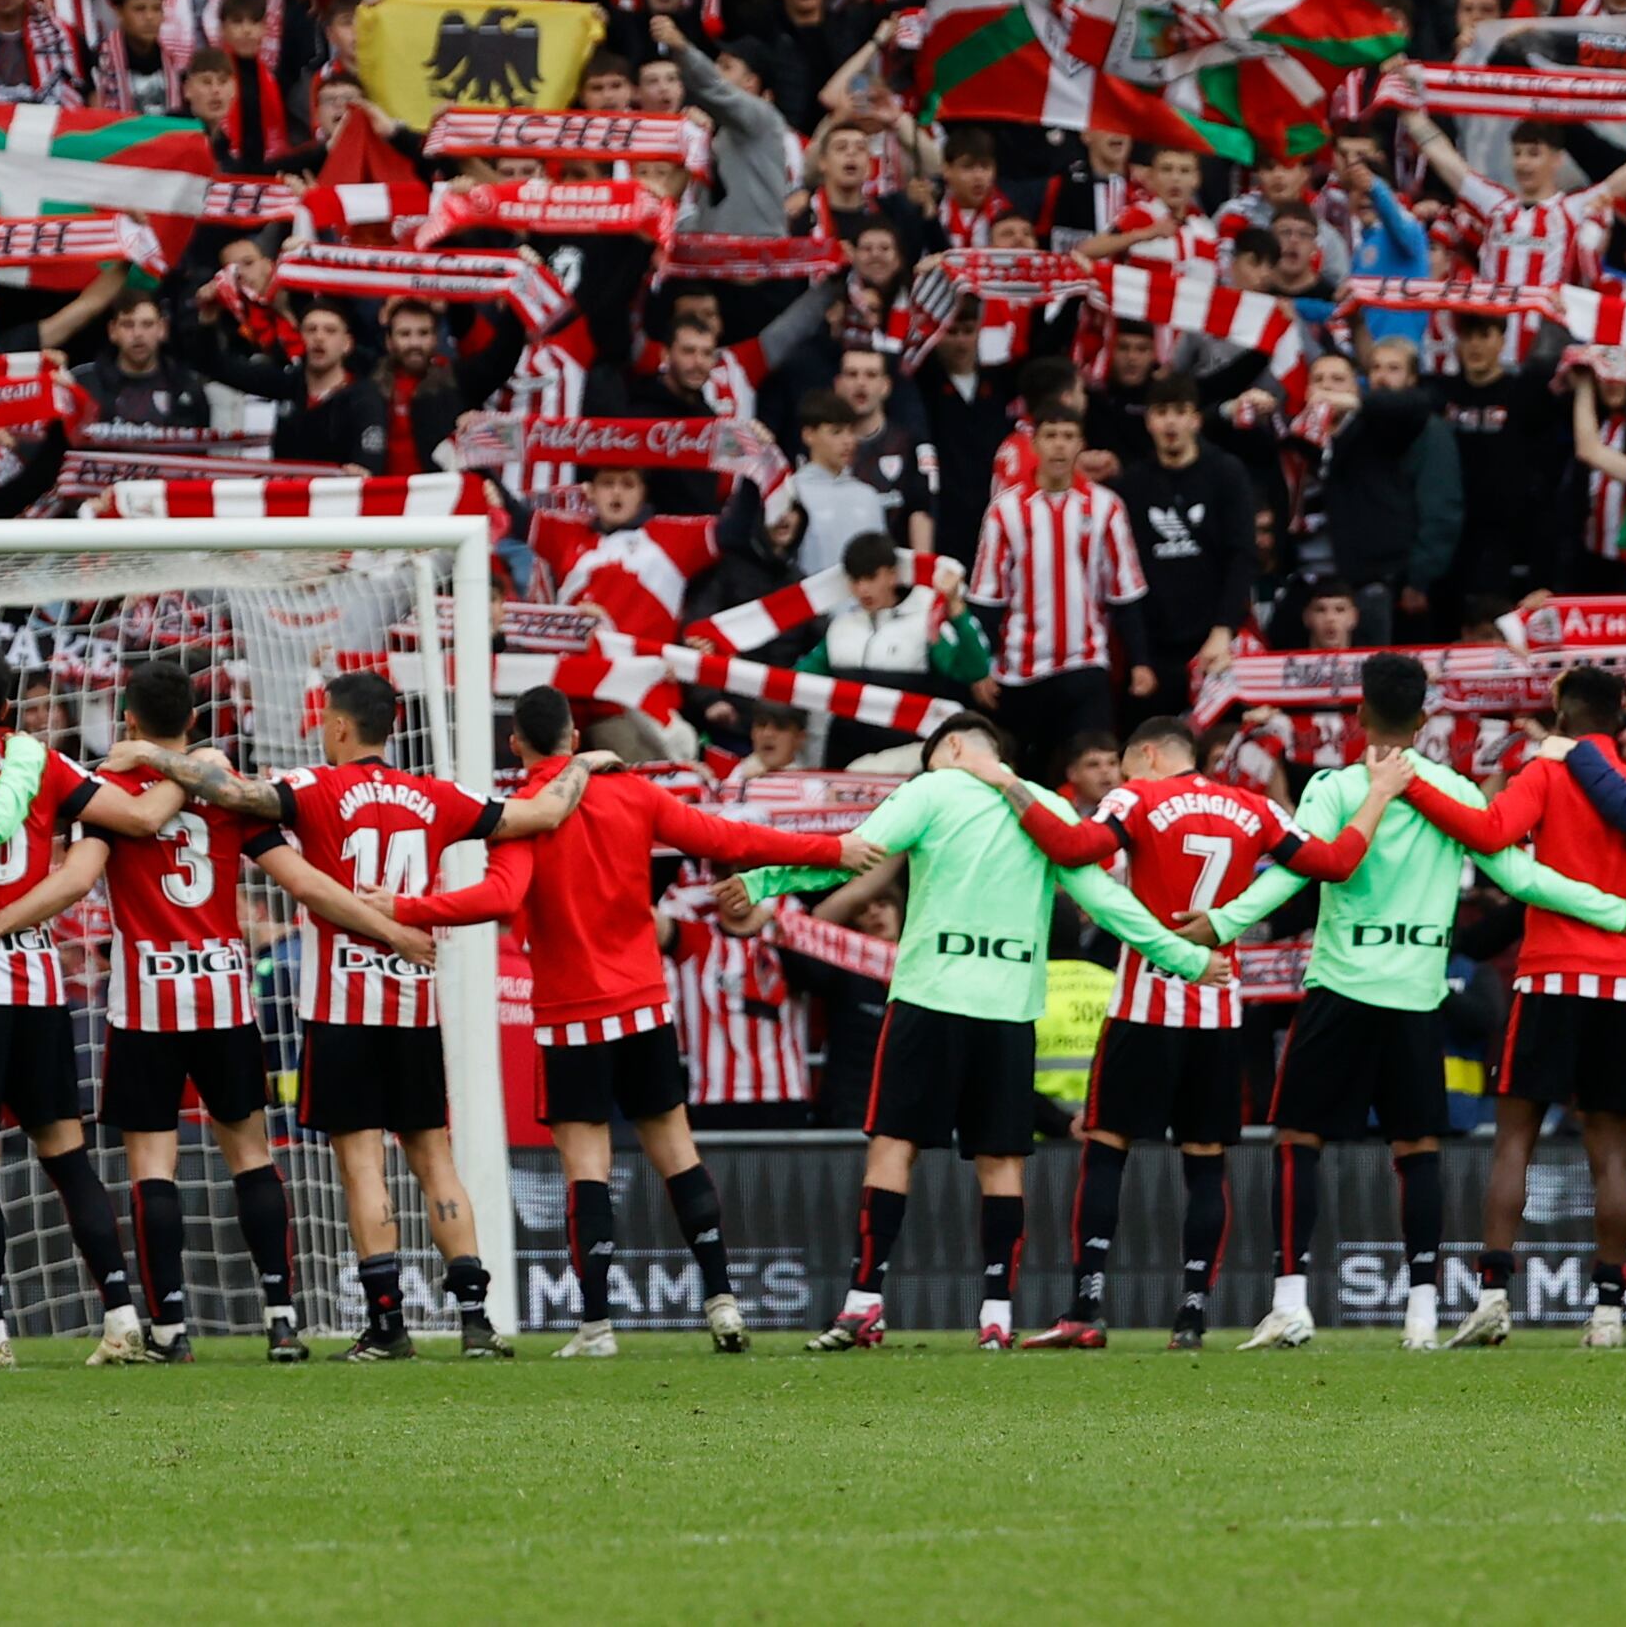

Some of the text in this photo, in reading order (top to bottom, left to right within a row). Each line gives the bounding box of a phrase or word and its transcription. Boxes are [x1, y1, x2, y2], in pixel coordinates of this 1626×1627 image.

[490, 114, 641, 147] ICHH
[1375, 276, 1523, 306] ICHH
[646, 418, 712, 459] Club
[1147, 791, 1261, 839] BERENGUER
[156, 810, 215, 910] 3
[340, 827, 429, 896] 14
[1182, 833, 1233, 915] 7
[937, 931, 1034, 965] DIGI
[1352, 923, 1455, 949] DIGI
[145, 949, 244, 978] DIGI
